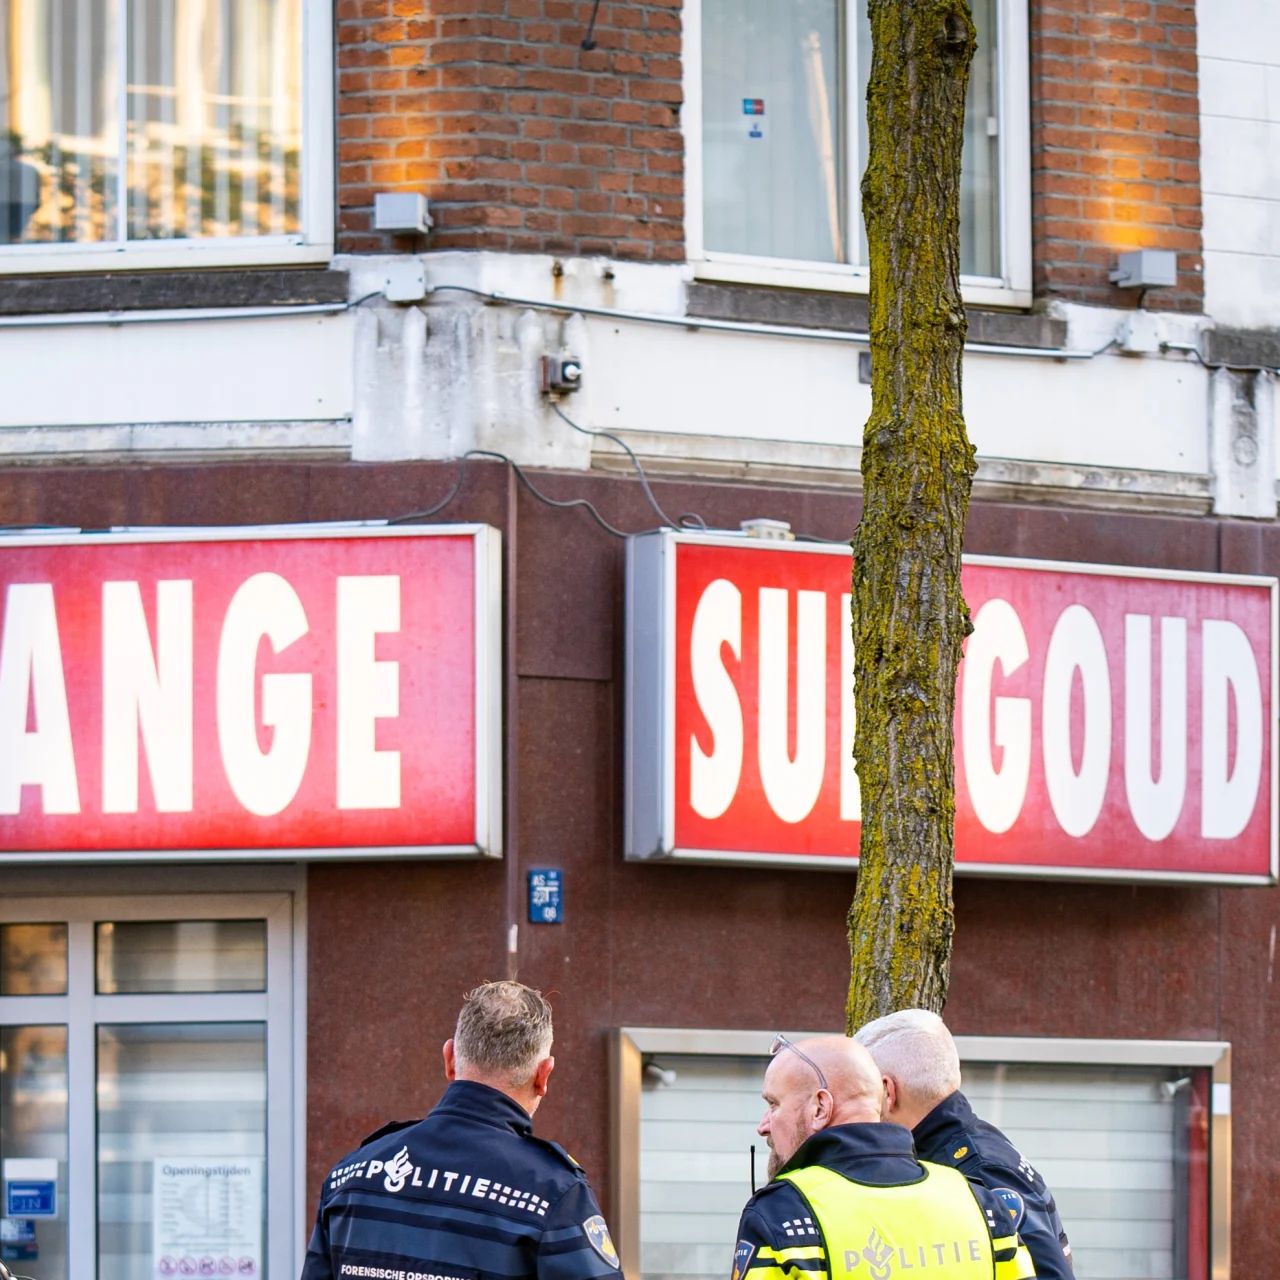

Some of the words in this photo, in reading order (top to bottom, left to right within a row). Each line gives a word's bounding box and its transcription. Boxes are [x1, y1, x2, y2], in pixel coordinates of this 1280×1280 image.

[690, 578, 1262, 842] SUGOUD
[162, 1164, 251, 1178] Openingstijden
[365, 1145, 490, 1198] POLITIE
